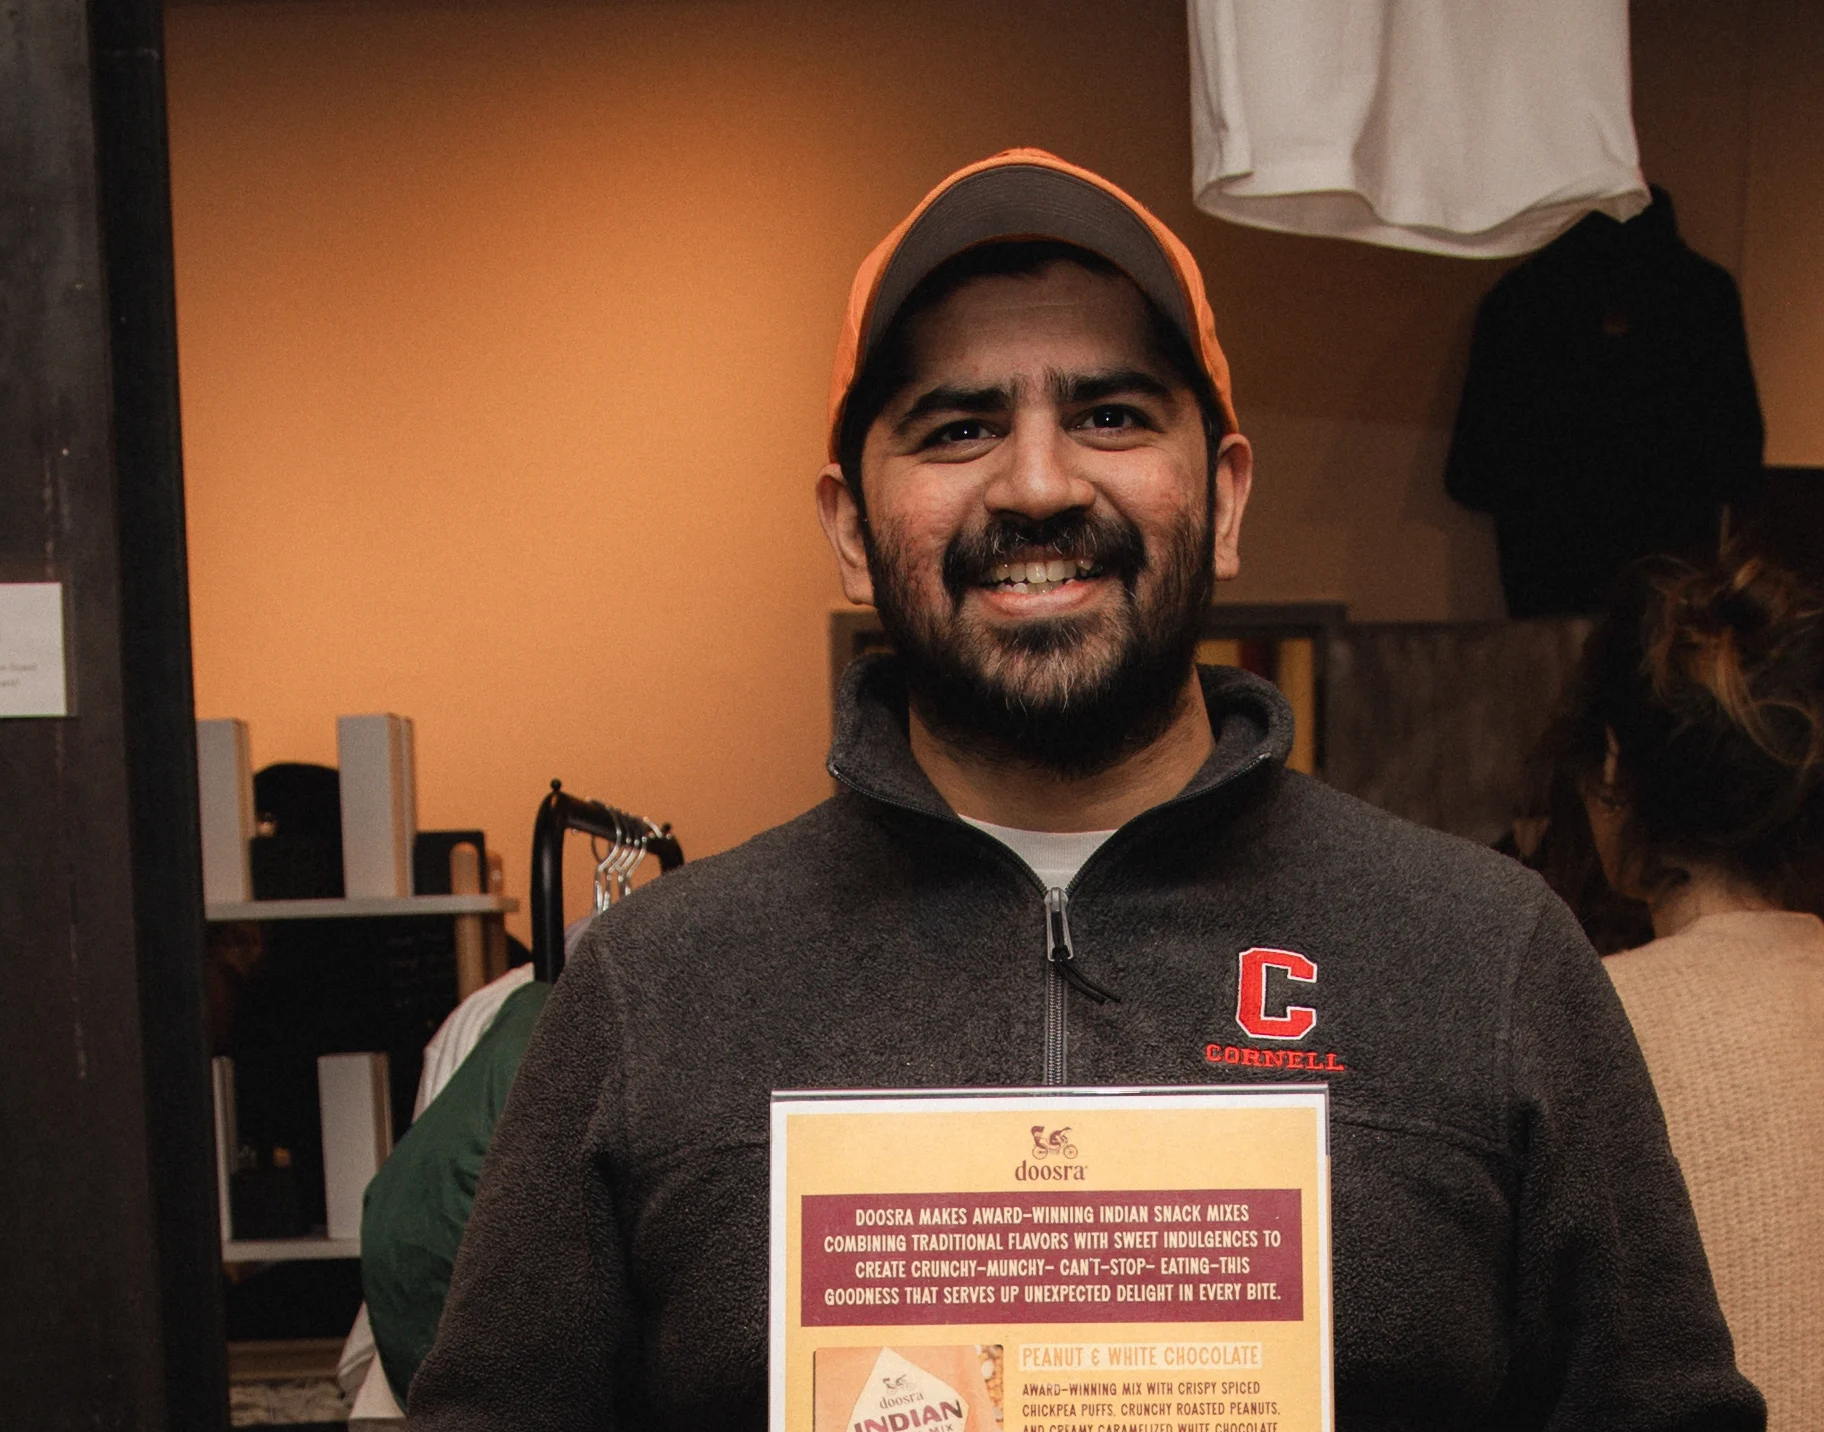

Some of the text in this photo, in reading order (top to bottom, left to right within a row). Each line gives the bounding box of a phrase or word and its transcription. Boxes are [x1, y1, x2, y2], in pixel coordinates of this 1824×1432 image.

[1236, 947, 1318, 1040] C
[1206, 1043, 1345, 1071] CORNELL
[856, 1205, 1249, 1225] DOOSRA MAKES AWARD-WINNING INDIAN SNACK MIXES
[824, 1231, 1280, 1252] COMBINING TRADITIONAL FLAVORS WITH SWEET INDULGENCES TO
[825, 1283, 1280, 1305] GOODNESS THAT SERVES UP UNEXPECTED DELIGHT IN EVERY BITE.
